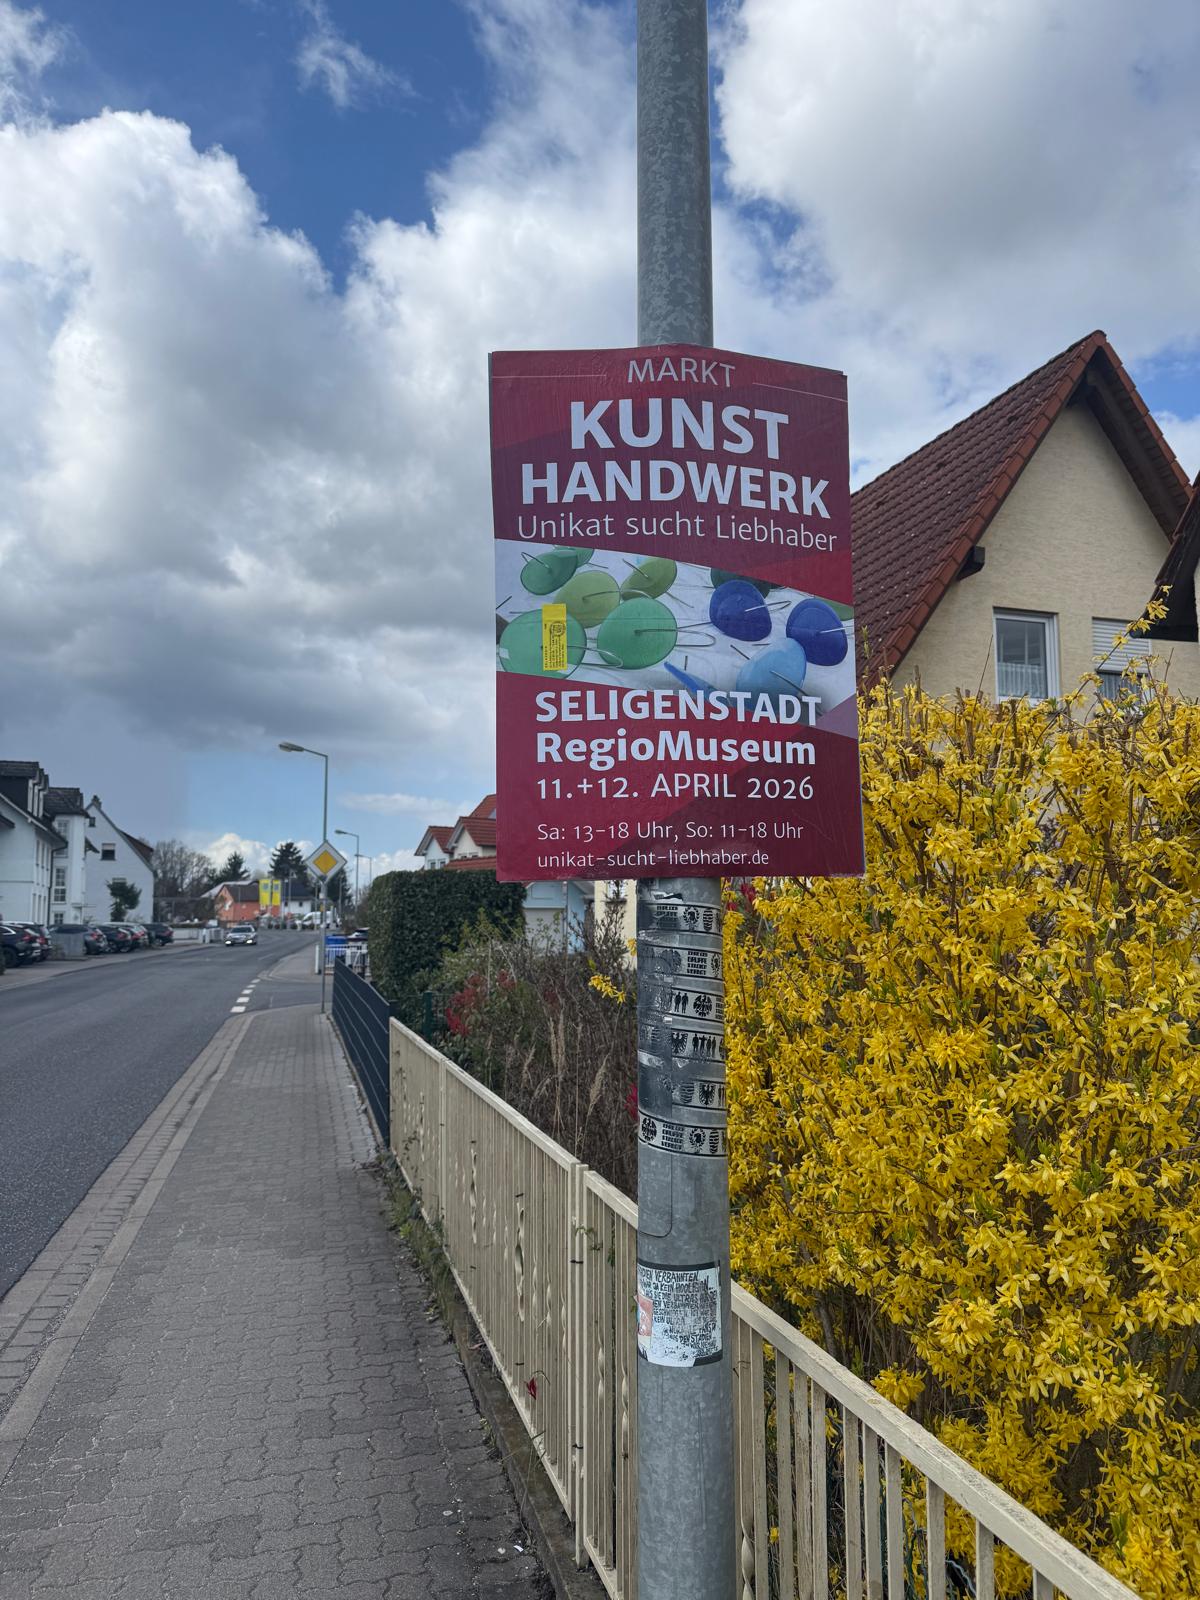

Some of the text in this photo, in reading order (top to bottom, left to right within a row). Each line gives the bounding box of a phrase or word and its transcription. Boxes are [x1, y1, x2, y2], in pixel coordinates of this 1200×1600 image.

[627, 357, 736, 388] MARKT
[570, 397, 789, 461] KUNST
[521, 459, 831, 519] HANDWERK
[518, 510, 838, 552] Unikat sucht Liebhaber
[535, 689, 823, 727] SELIGENSTADT
[536, 727, 816, 771] RegioMuseum
[650, 773, 737, 798] APRIL
[747, 775, 814, 800] 2026
[537, 823, 565, 840] Sa:
[637, 820, 679, 843] Uhr,
[686, 821, 713, 838] So:
[774, 821, 804, 839] Uhr
[538, 848, 769, 868] unikat-sucht-liebhaber.de
